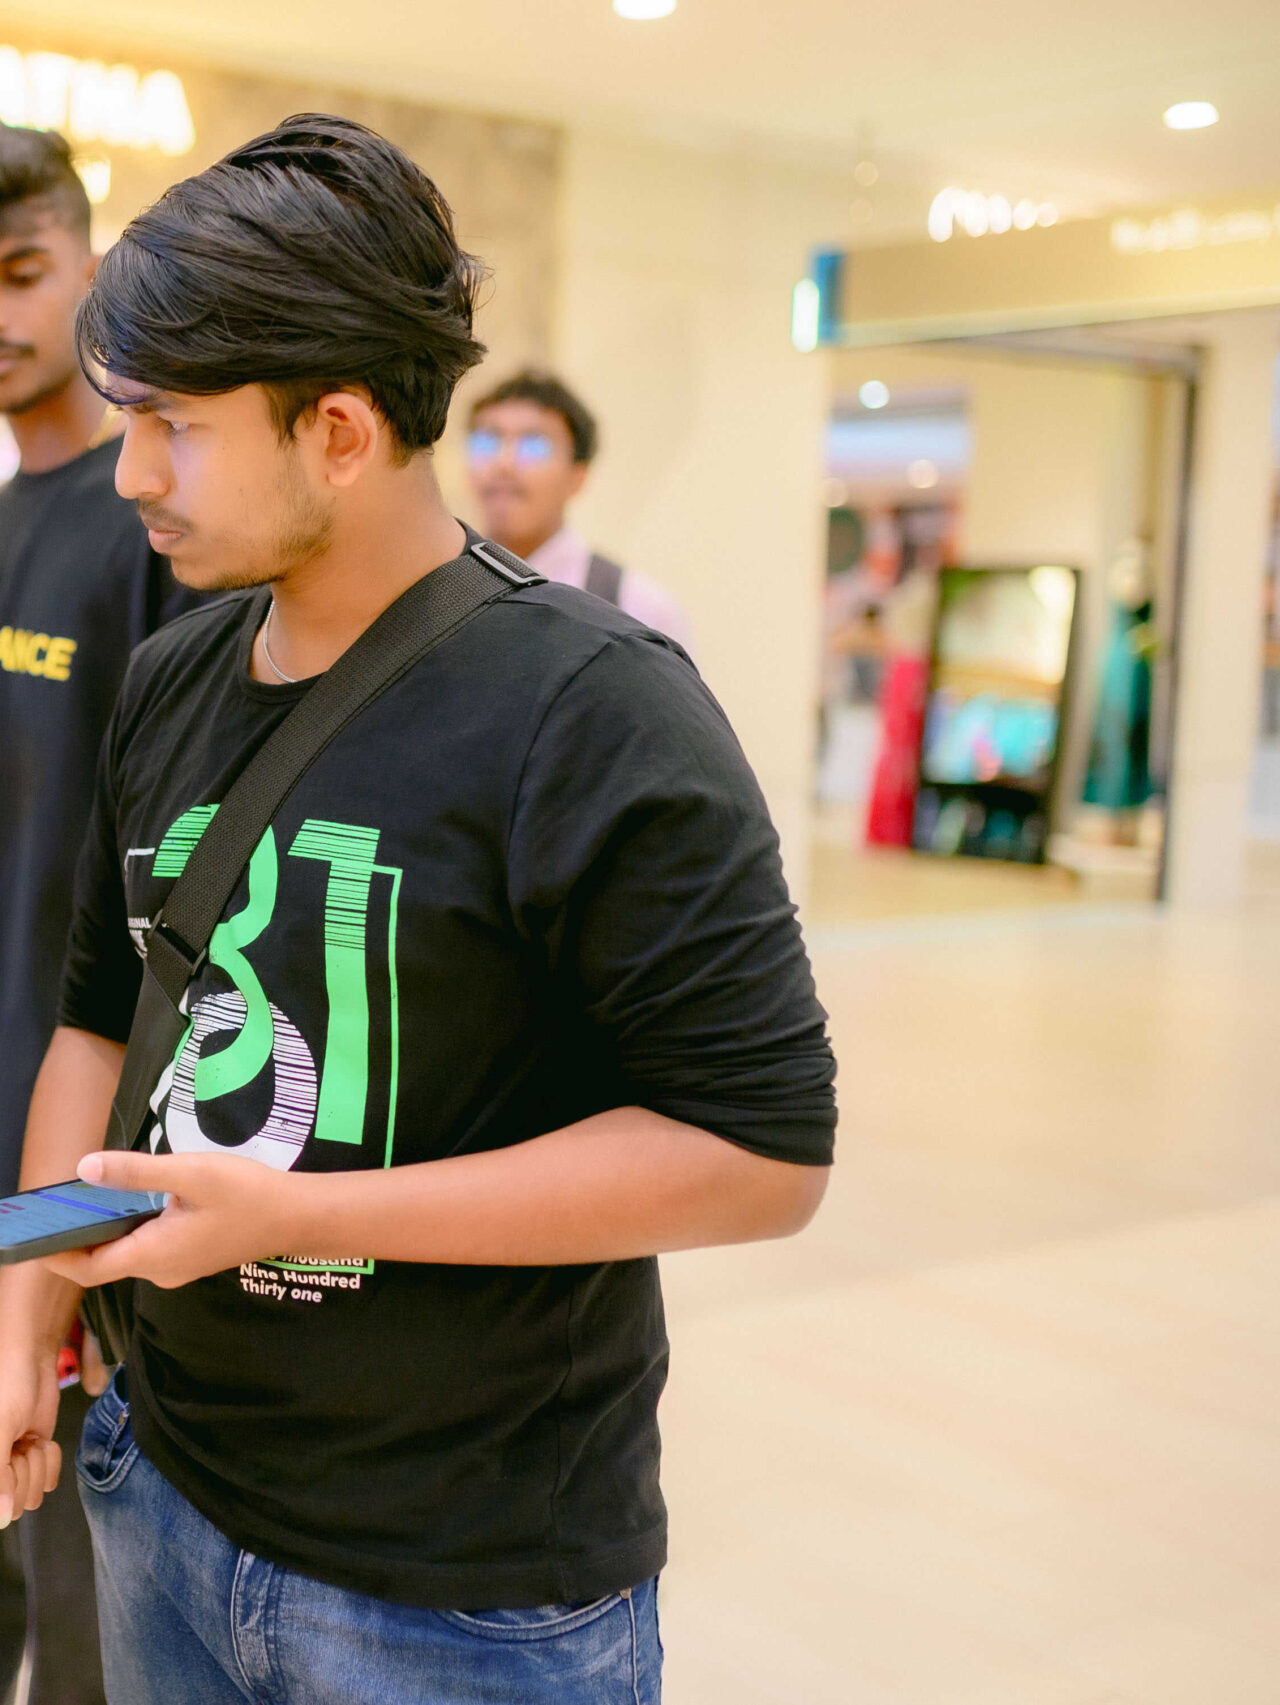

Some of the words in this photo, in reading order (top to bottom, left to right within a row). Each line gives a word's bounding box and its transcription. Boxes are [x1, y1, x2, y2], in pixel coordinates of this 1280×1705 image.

[239, 1263, 279, 1281] Nine
[283, 1270, 361, 1290] Hundred
[240, 1278, 287, 1301] Thirty
[290, 1288, 323, 1303] one
